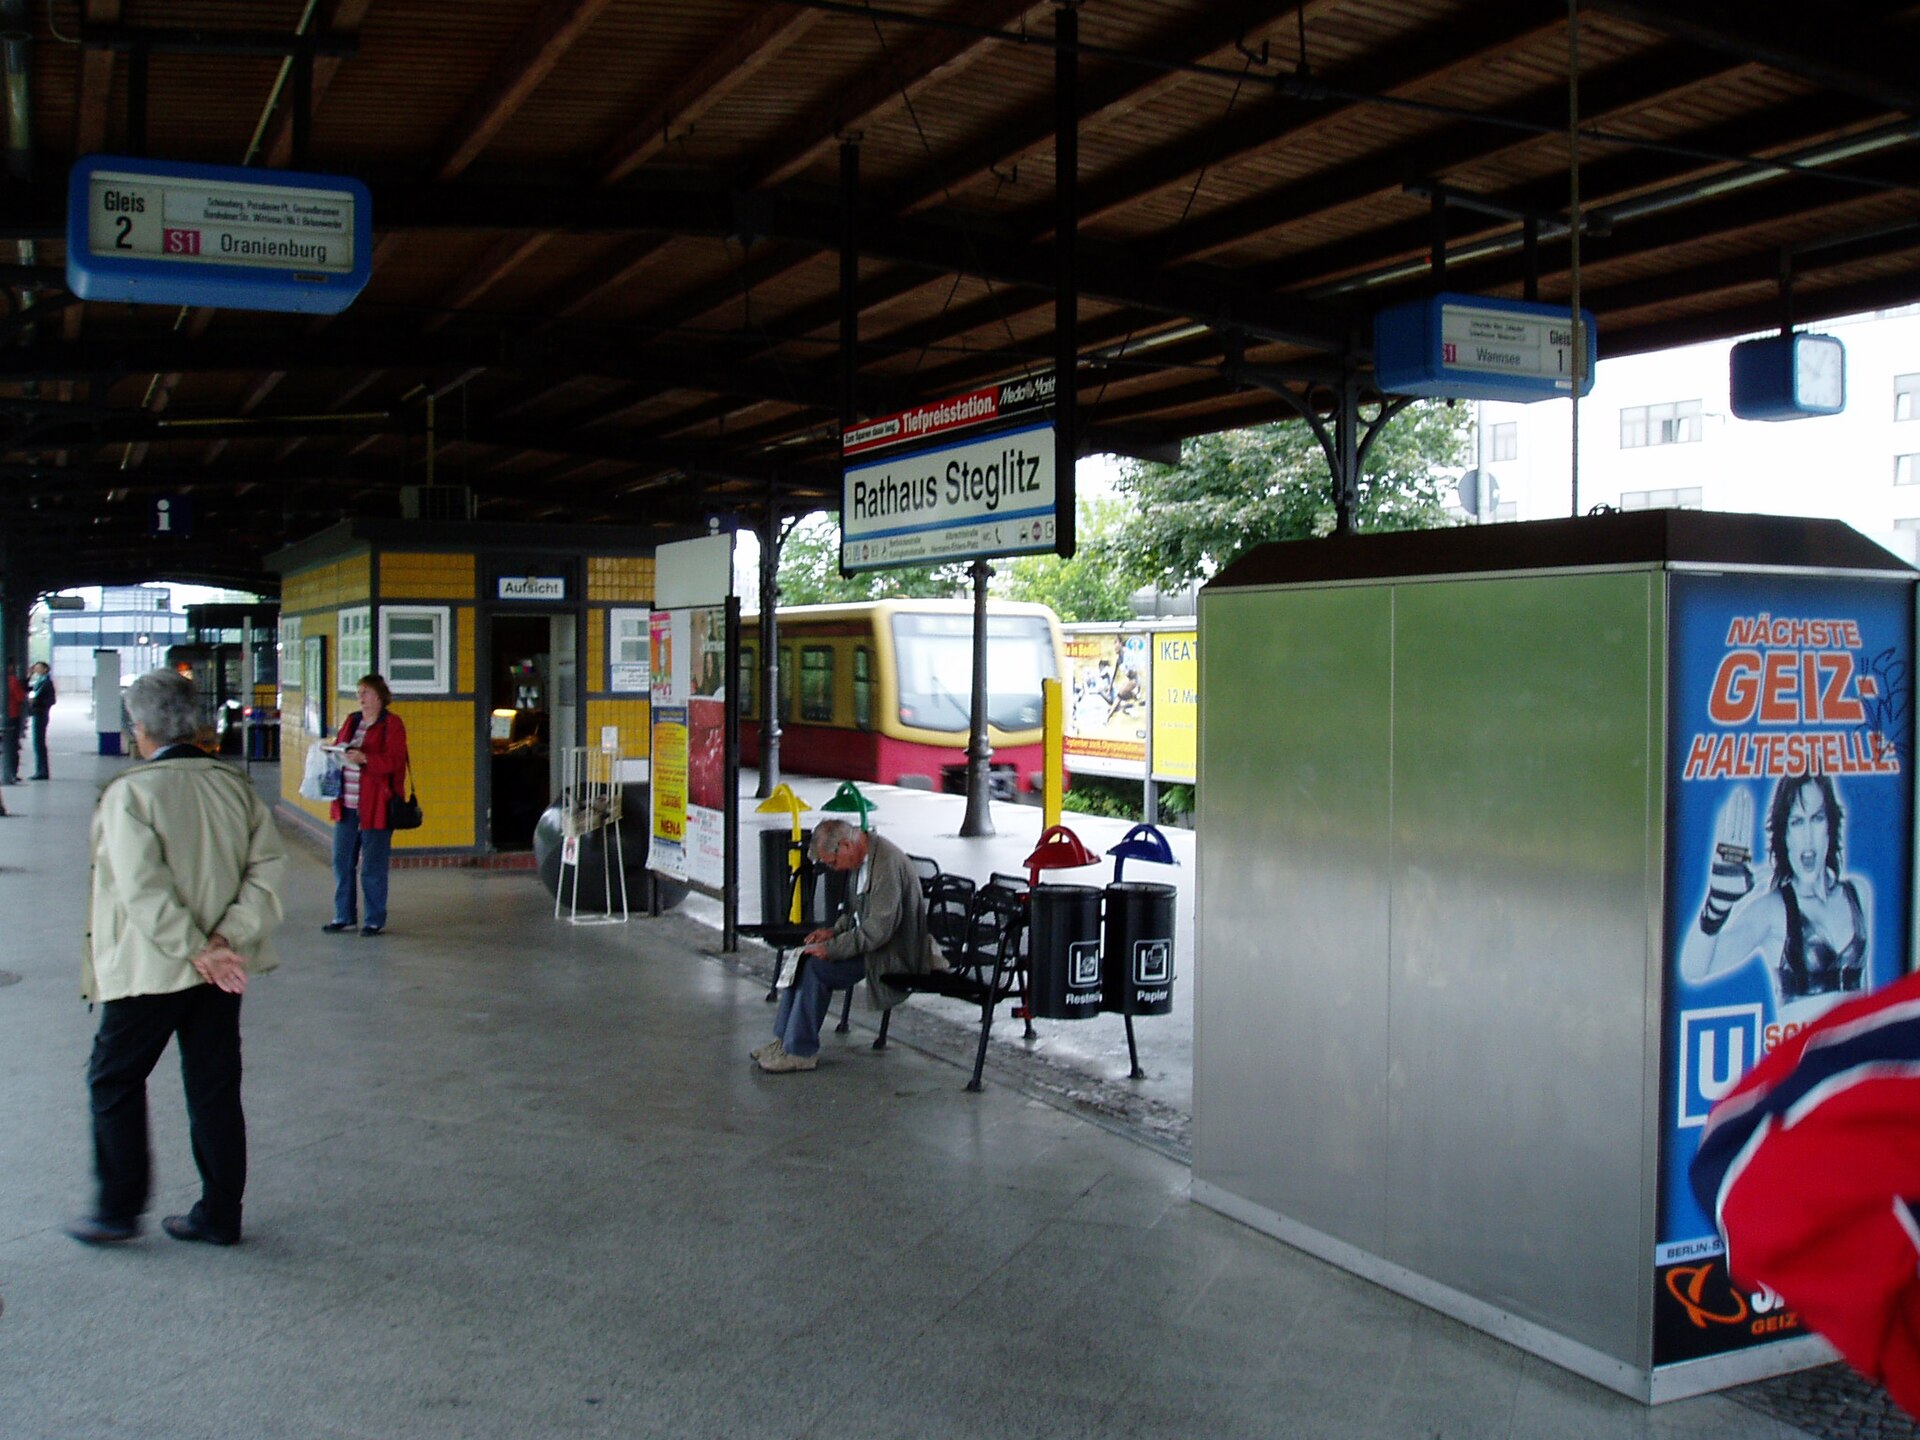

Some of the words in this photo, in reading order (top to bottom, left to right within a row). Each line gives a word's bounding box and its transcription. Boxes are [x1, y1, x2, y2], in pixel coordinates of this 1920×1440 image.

[104, 190, 145, 213] Gleis
[115, 215, 133, 250] 2
[171, 231, 195, 254] S1
[220, 232, 326, 263] Oranienburg
[1476, 347, 1521, 366] Wannsee
[1556, 349, 1563, 372] 1
[902, 394, 996, 435] Tiefpreisstation.
[854, 475, 938, 520] Rathaus
[945, 449, 1040, 511] Steglitz
[505, 581, 559, 594] Aufsicht
[1726, 612, 1862, 648] NÄCHSTE
[1160, 641, 1191, 661] IKEA
[1167, 688, 1178, 704] 12
[1708, 648, 1878, 725] GEIZ-
[1137, 989, 1168, 1004] Papier
[1751, 1312, 1799, 1335] GEIZ
